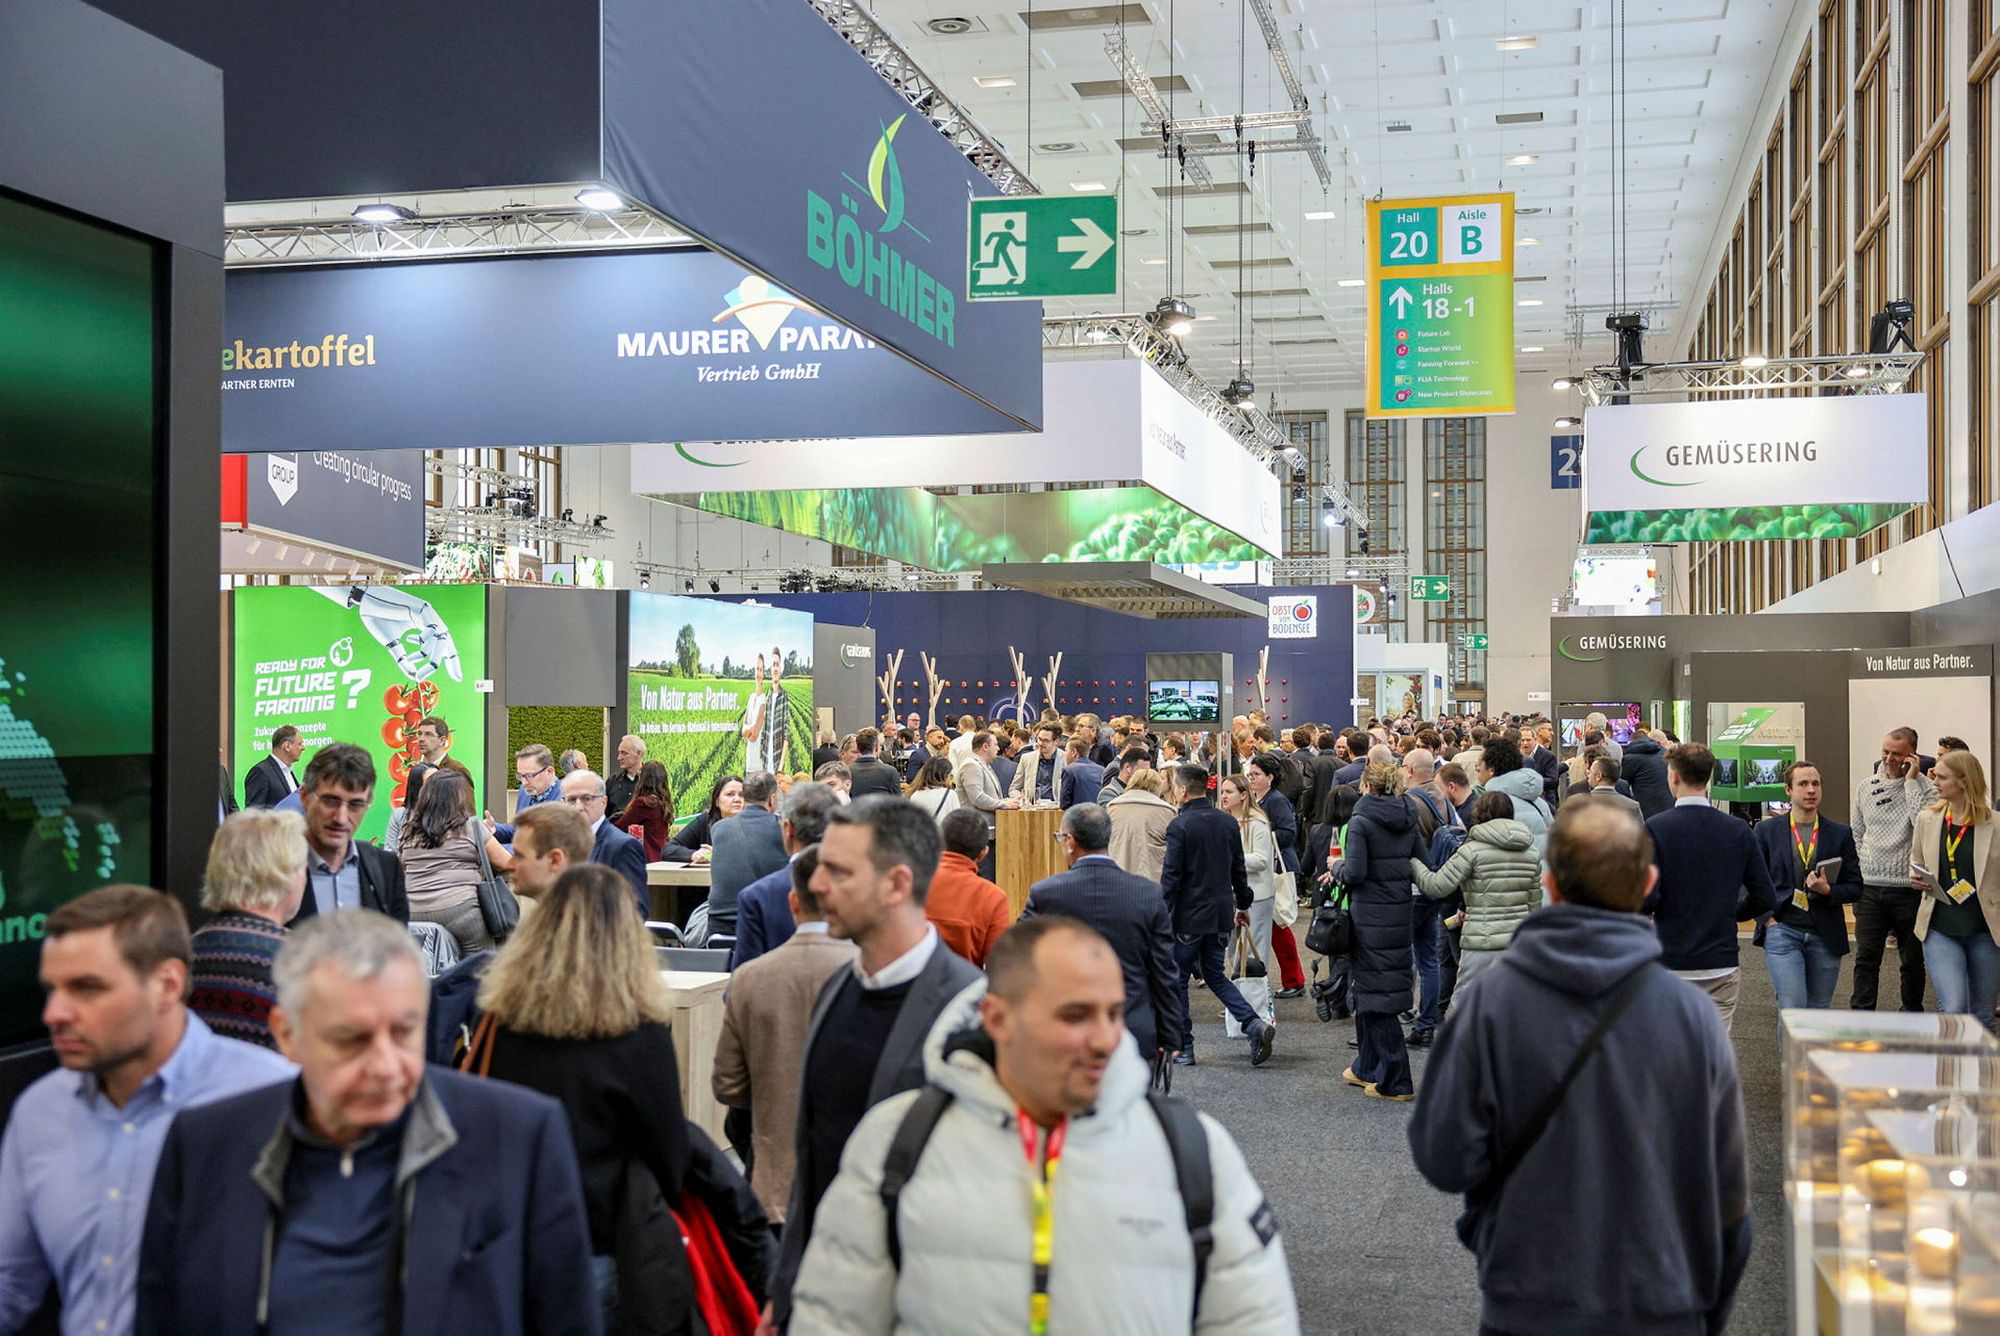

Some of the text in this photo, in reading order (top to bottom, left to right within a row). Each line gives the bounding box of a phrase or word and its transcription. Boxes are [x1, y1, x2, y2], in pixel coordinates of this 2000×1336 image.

[1397, 212, 1419, 224] Hall
[1458, 210, 1486, 220] Aisle
[1390, 231, 1428, 258] 20
[1461, 226, 1482, 255] B
[808, 189, 955, 348] BÖHMER
[1422, 283, 1453, 295] Halls
[222, 334, 376, 370] ekartoffel
[618, 329, 750, 357] MAURER
[697, 363, 822, 382] Vertrieb GmbH
[222, 378, 294, 390] ARTNER ERNTEN
[1666, 440, 1817, 466] GEMÜSERING
[272, 464, 294, 484] GROUP
[352, 456, 380, 488] circular
[381, 474, 412, 502] progress
[1272, 605, 1291, 615] OBST
[1272, 623, 1310, 634] BODENSEE
[1580, 634, 1666, 649] GEMÜSERING
[255, 656, 326, 674] READY FOR
[1866, 654, 1974, 671] Von Natur aus Partner.
[254, 672, 338, 697] FUTURE
[254, 694, 336, 717] FARMING
[641, 684, 740, 710] Von Natur aus Partner.
